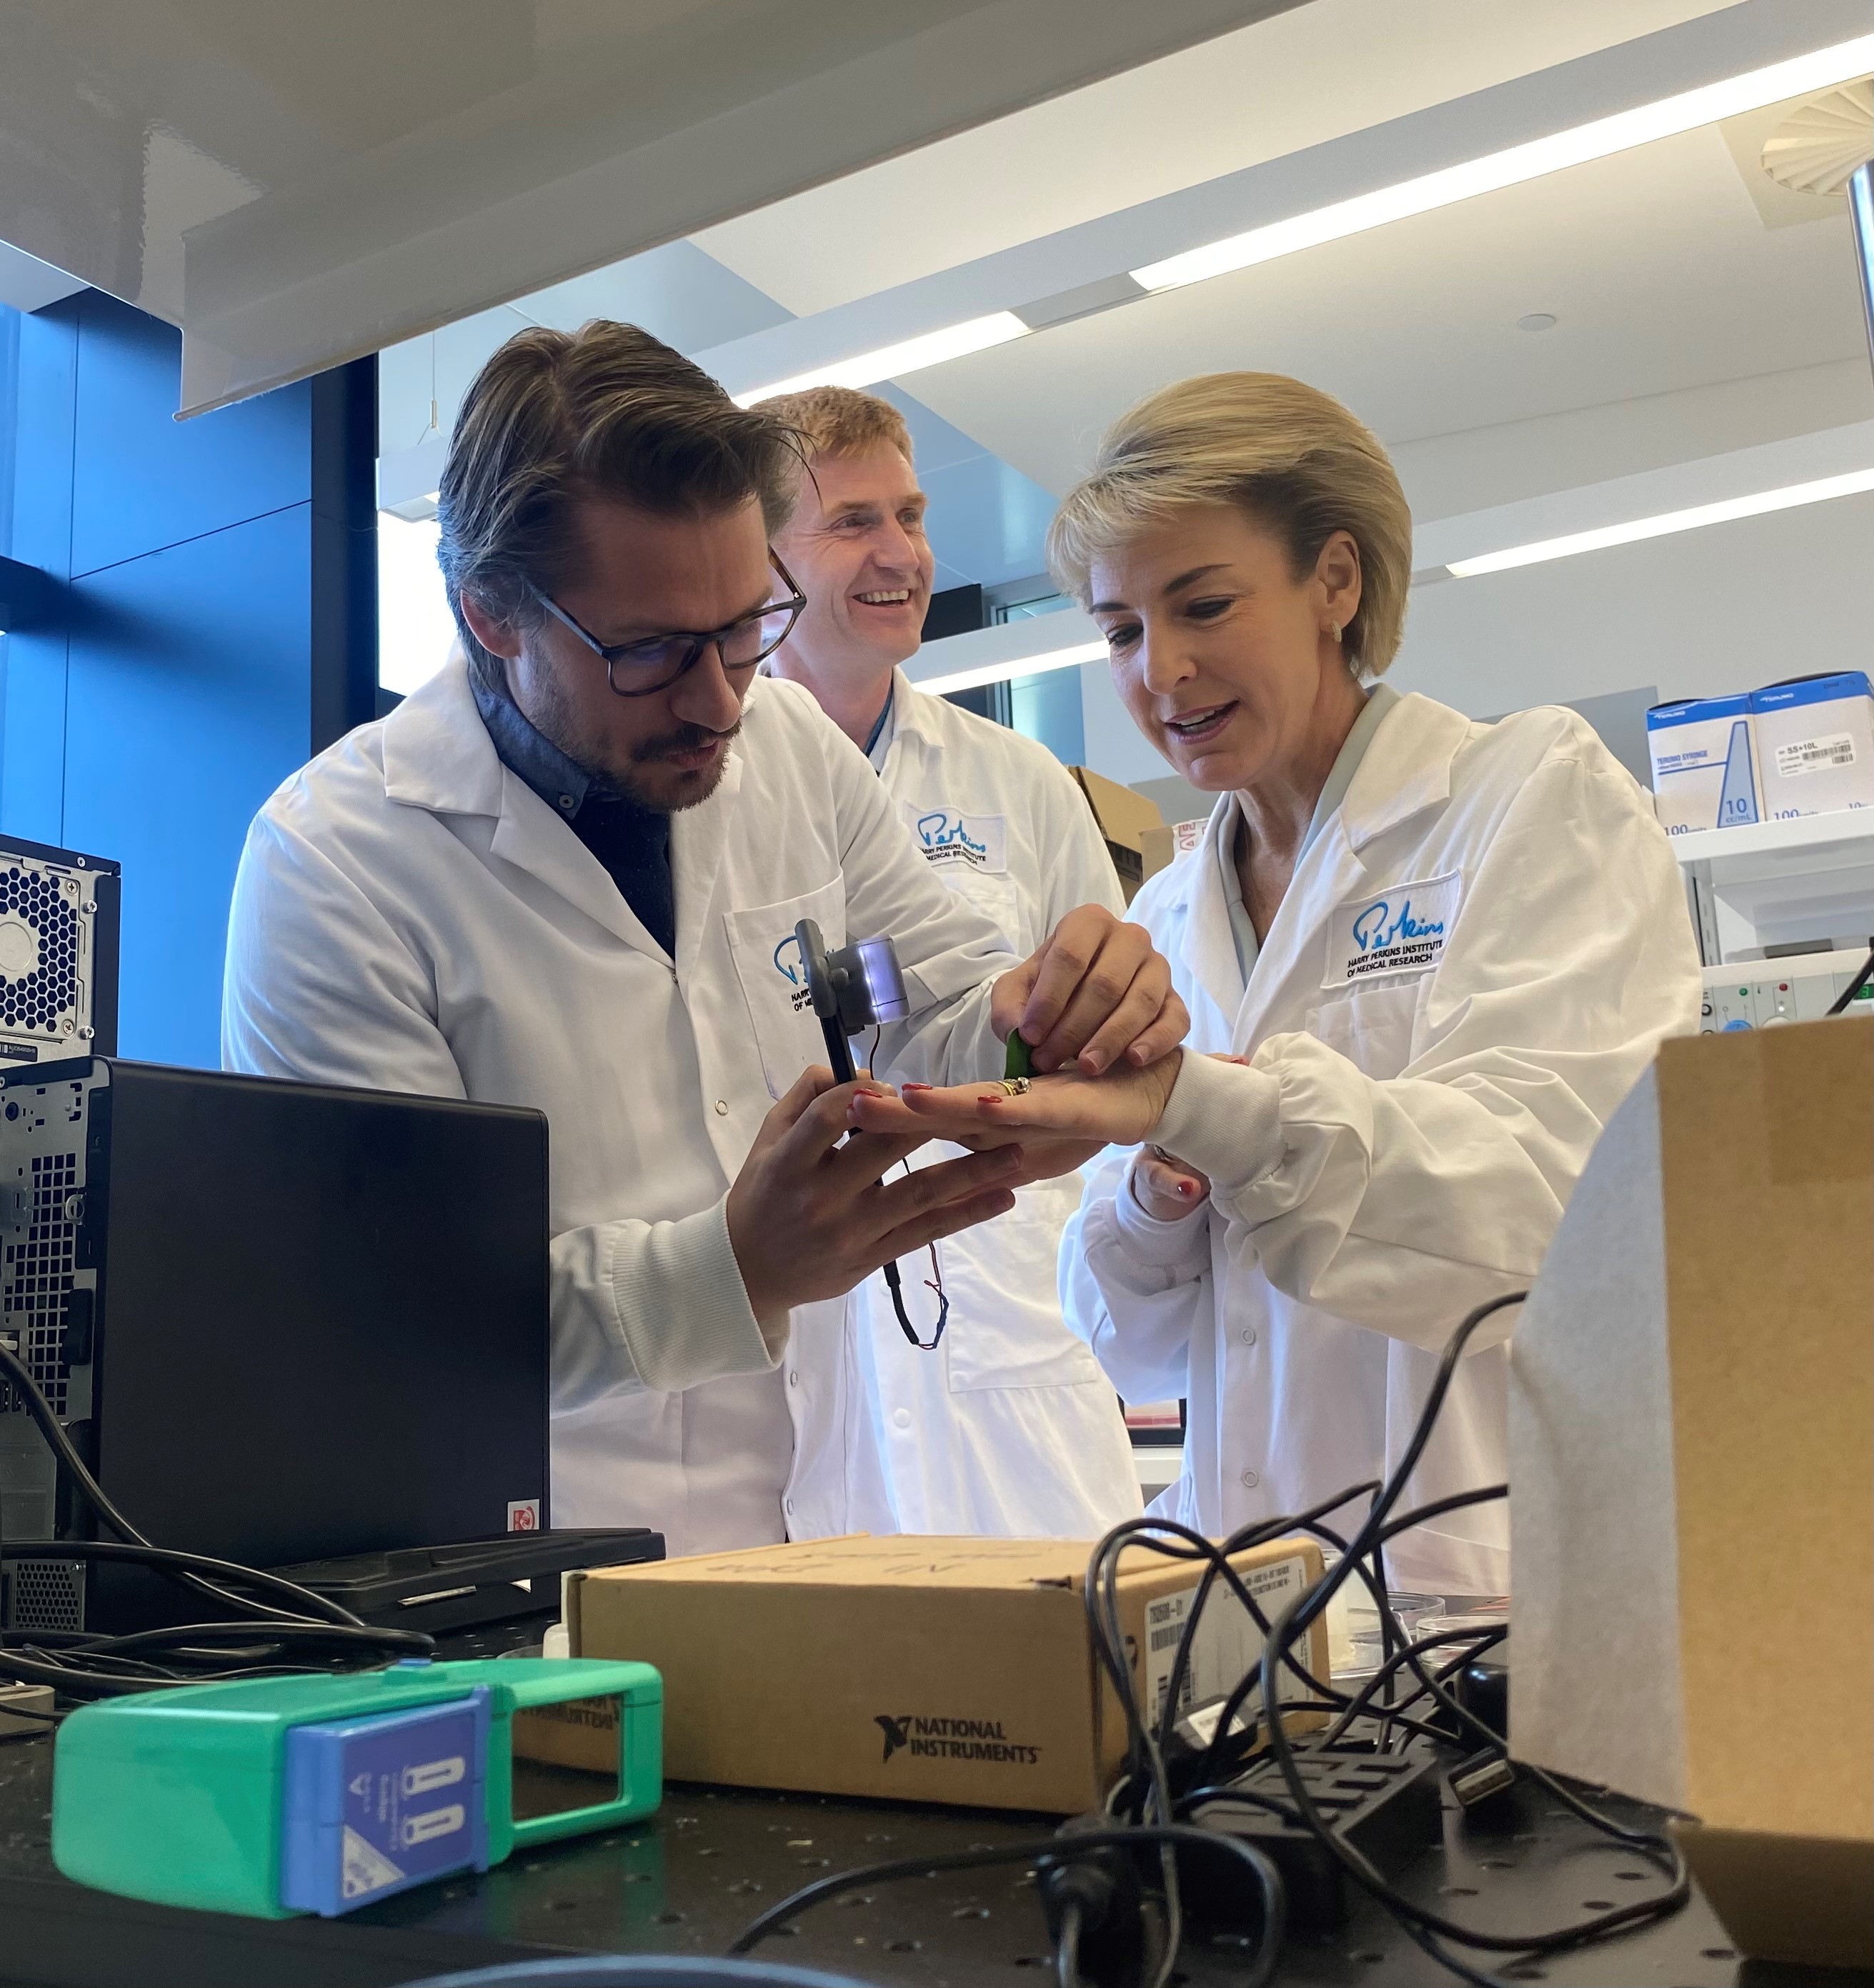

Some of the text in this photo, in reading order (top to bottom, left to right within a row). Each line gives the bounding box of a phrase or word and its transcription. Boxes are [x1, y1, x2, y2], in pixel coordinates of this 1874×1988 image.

[1726, 798, 1747, 815] 10
[1726, 814, 1752, 823] cc/mL
[917, 813, 987, 853] Perkins
[1664, 824, 1688, 836] 100
[1352, 899, 1443, 951] Perkins
[1347, 954, 1370, 968] HARRY
[1370, 946, 1401, 961] PERKINS
[1347, 953, 1432, 978] OF MEDICAL RESEARCH
[791, 988, 809, 1002] HARR
[794, 1002, 803, 1012] OF
[914, 1716, 1006, 1740] NATIONAL
[911, 1739, 1042, 1764] INSTRUMENTS
